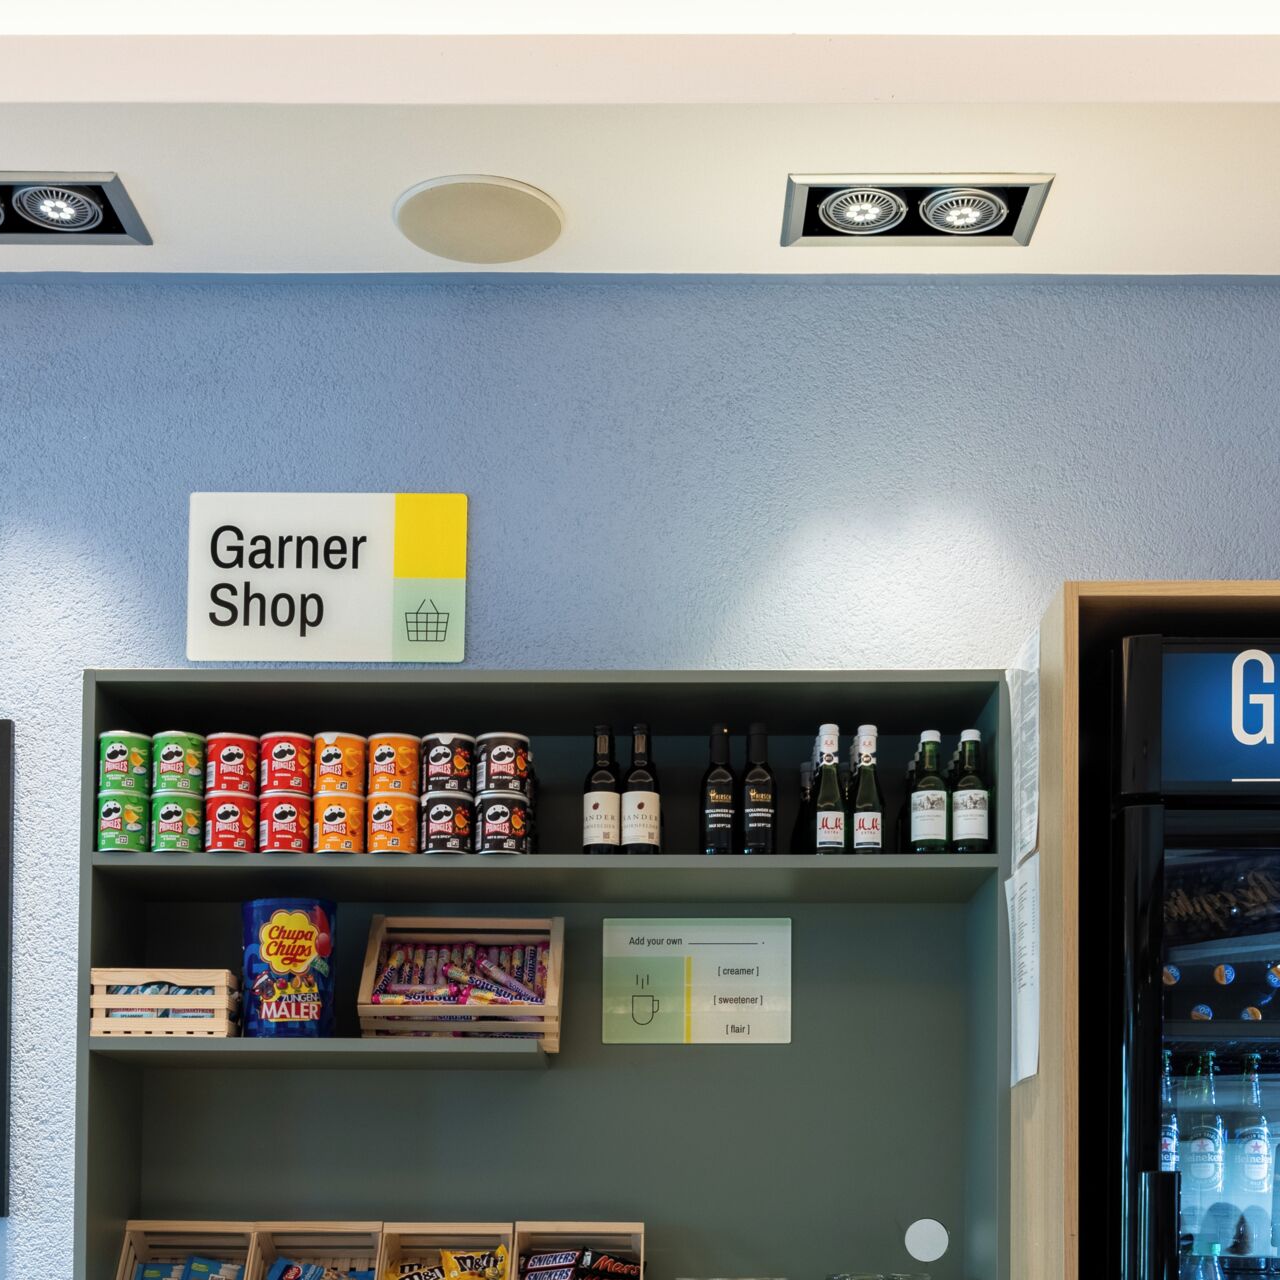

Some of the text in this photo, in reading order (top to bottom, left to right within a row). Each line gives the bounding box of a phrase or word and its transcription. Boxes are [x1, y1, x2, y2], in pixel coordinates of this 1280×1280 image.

[210, 524, 367, 570] Garner
[209, 581, 324, 638] Shop
[268, 926, 314, 944] Chupa
[629, 937, 645, 945] Add
[646, 938, 664, 947] your
[266, 940, 312, 960] Chups
[722, 968, 755, 976] creamer
[718, 996, 758, 1005] sweetener
[261, 1002, 319, 1019] MALER
[731, 1024, 745, 1033] flair
[529, 1252, 577, 1268] SNICKERS
[592, 1255, 640, 1275] Mars
